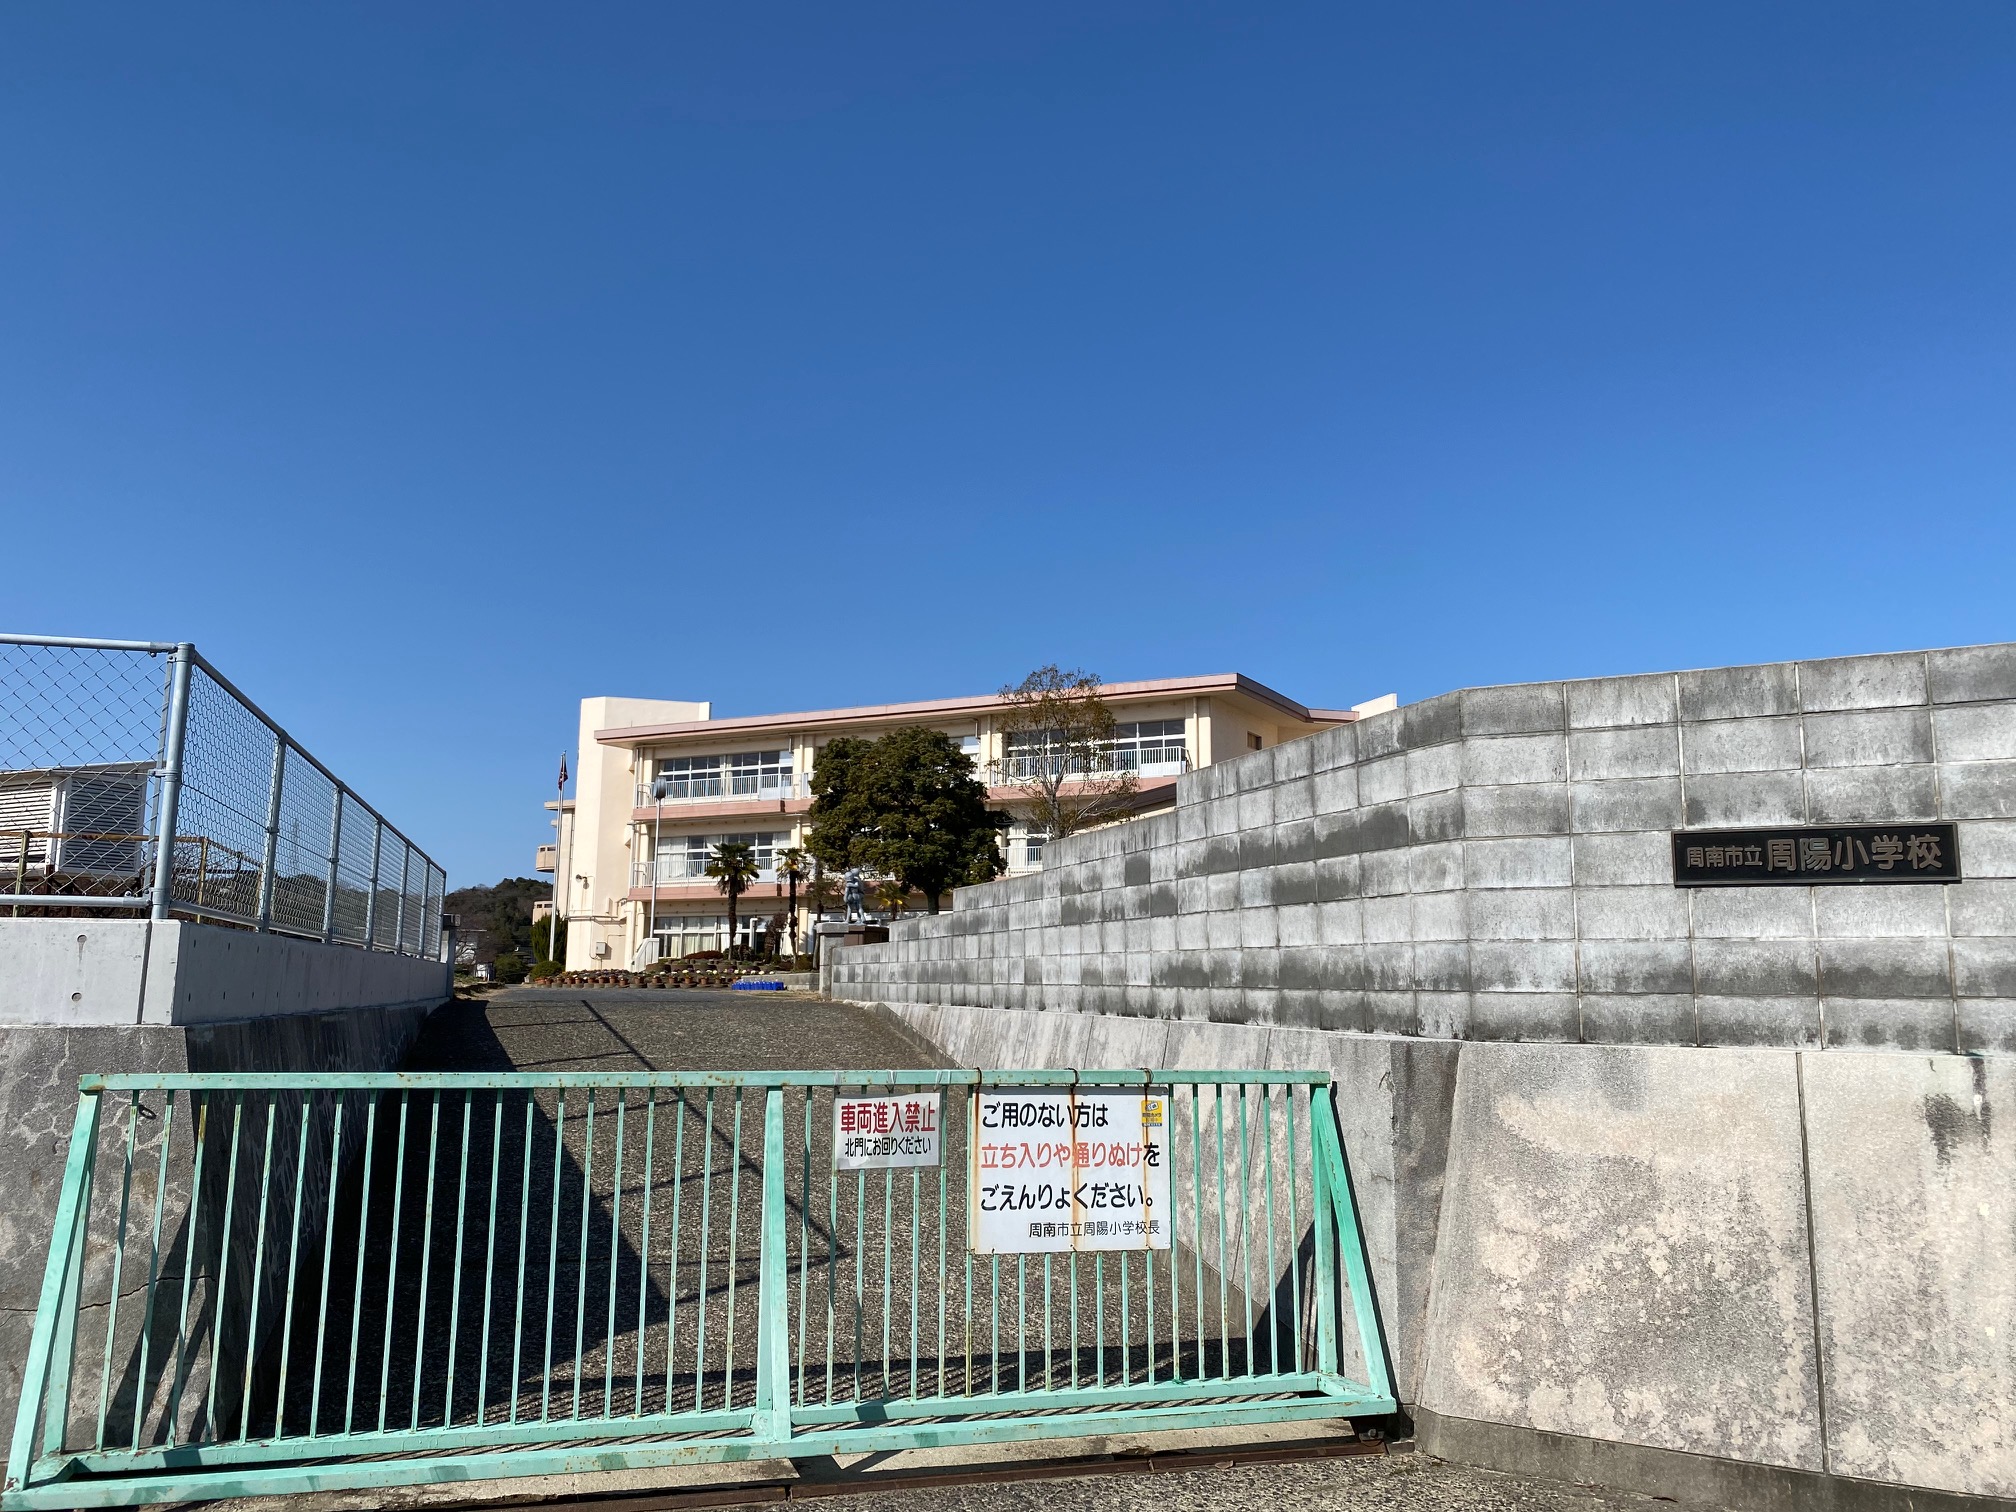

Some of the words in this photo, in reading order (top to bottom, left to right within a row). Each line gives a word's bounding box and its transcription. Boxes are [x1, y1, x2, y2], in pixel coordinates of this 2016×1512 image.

[1686, 834, 1943, 871] 周南市立周陽小学校
[841, 1101, 935, 1134] 車両進入禁止
[982, 1101, 1109, 1128] ご用のない方は
[845, 1136, 931, 1157] 北門にお回りください
[981, 1142, 1160, 1168] 立ち入りや通りぬけを
[981, 1183, 1153, 1211] ごえんりょください。
[1029, 1219, 1160, 1237] 周南市立周陽小学校長
